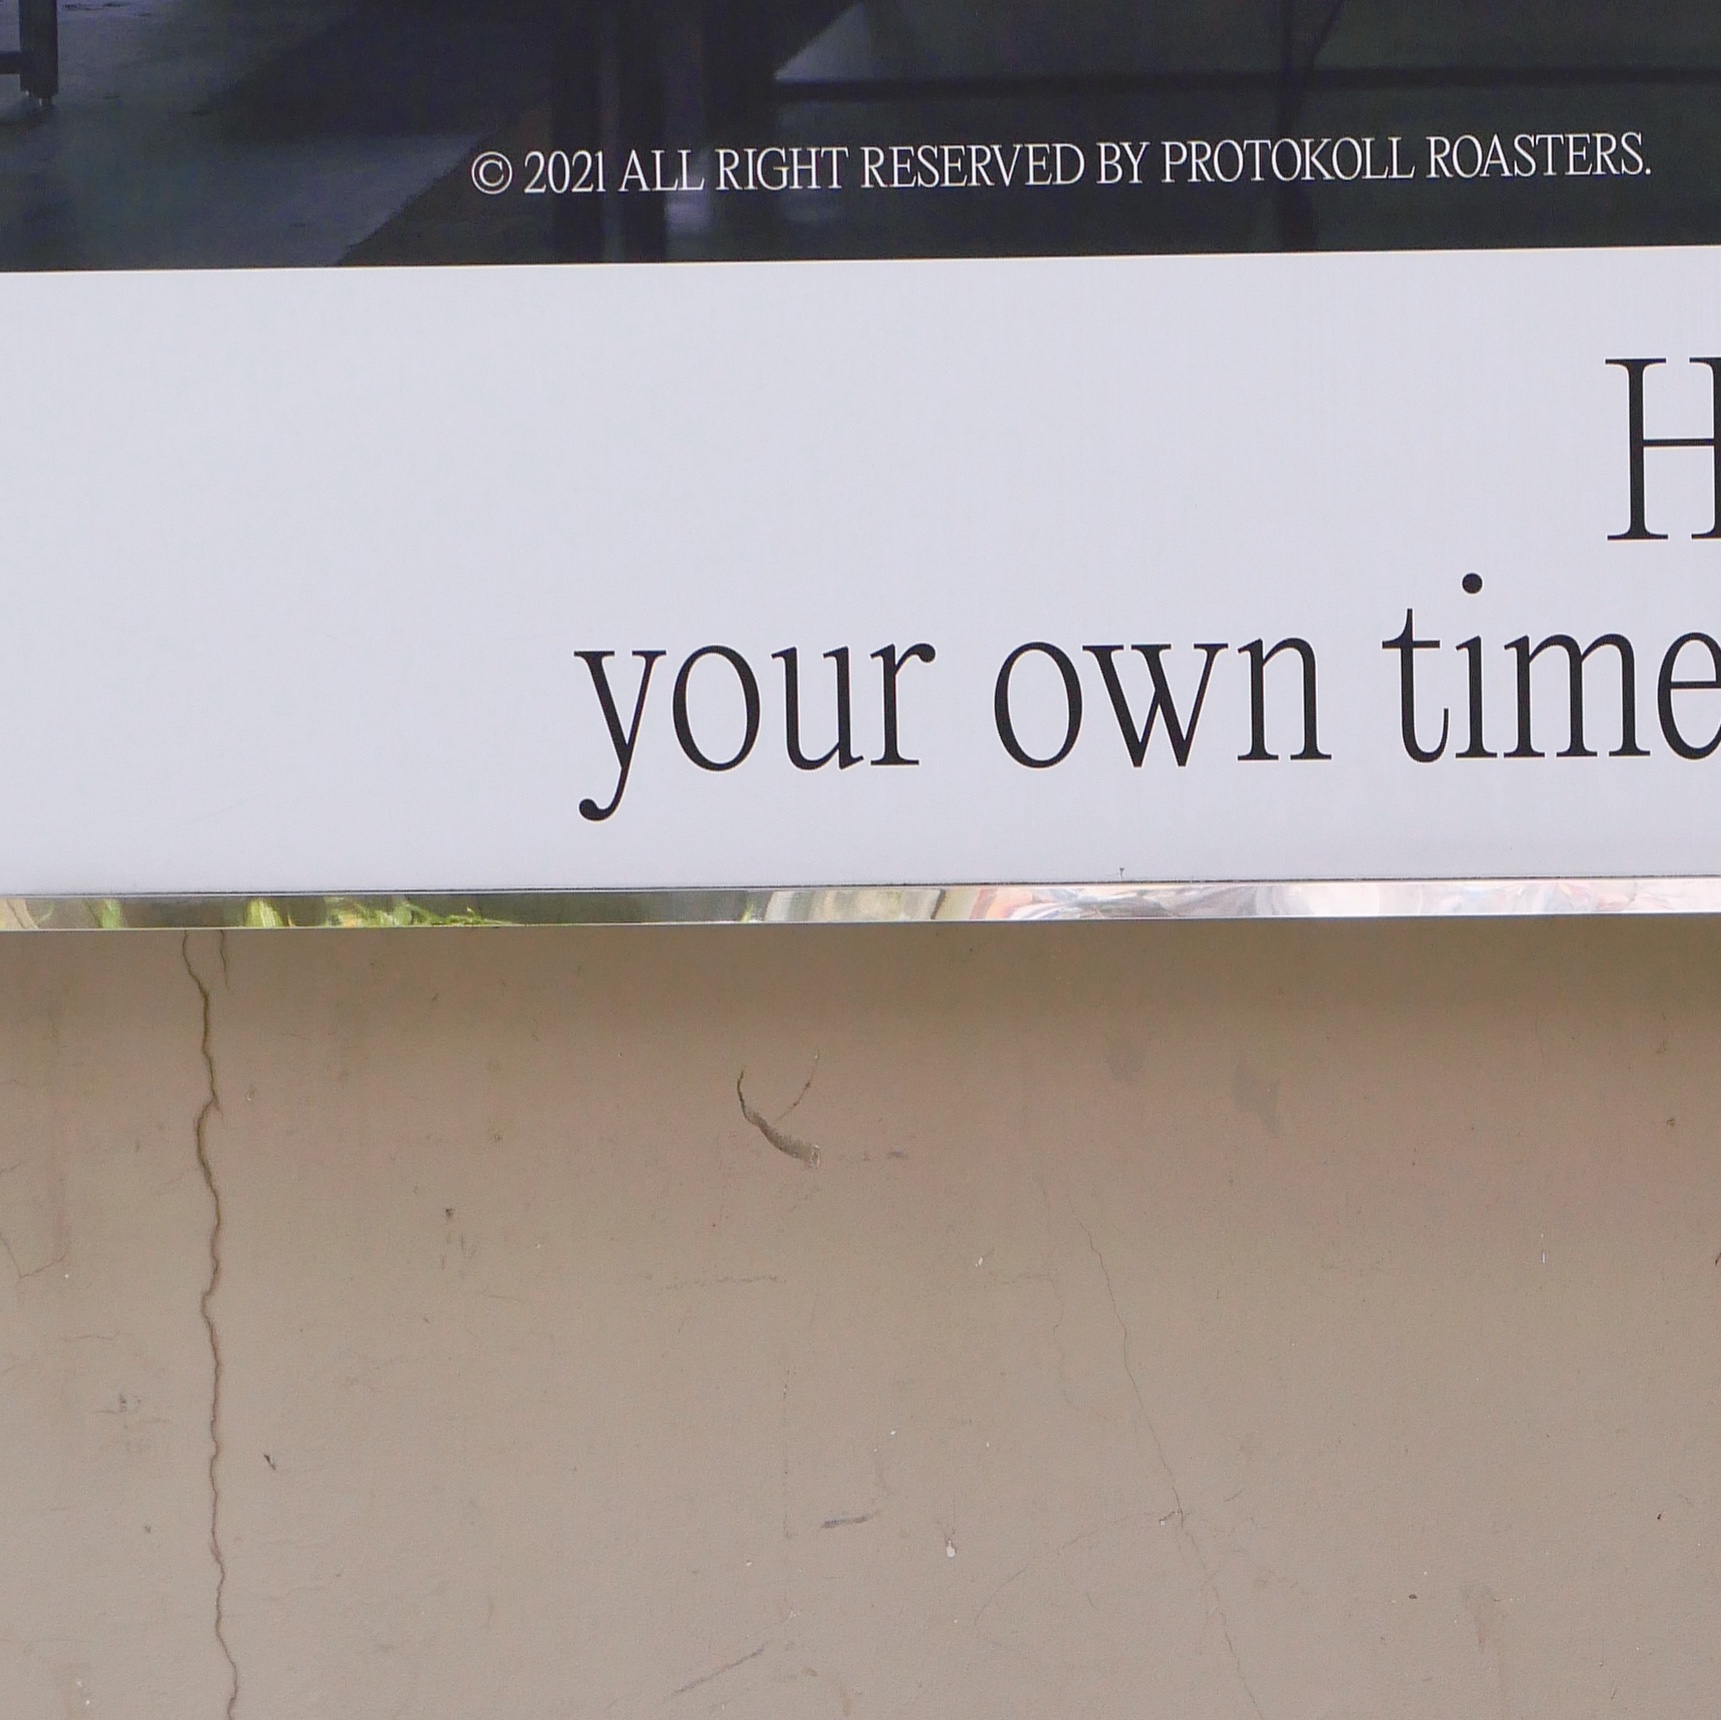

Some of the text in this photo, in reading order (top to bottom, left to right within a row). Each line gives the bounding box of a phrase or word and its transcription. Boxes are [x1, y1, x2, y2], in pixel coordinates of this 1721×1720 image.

[524, 150, 606, 194] 2021
[618, 149, 705, 192] ALL
[715, 146, 849, 191] RIGHT
[860, 143, 1085, 188] RESERVED
[1096, 141, 1150, 184] BY
[1161, 136, 1416, 183] PROTOKOLL
[1426, 131, 1651, 179] ROASTERS.
[573, 643, 936, 822] your
[994, 637, 1332, 769] own
